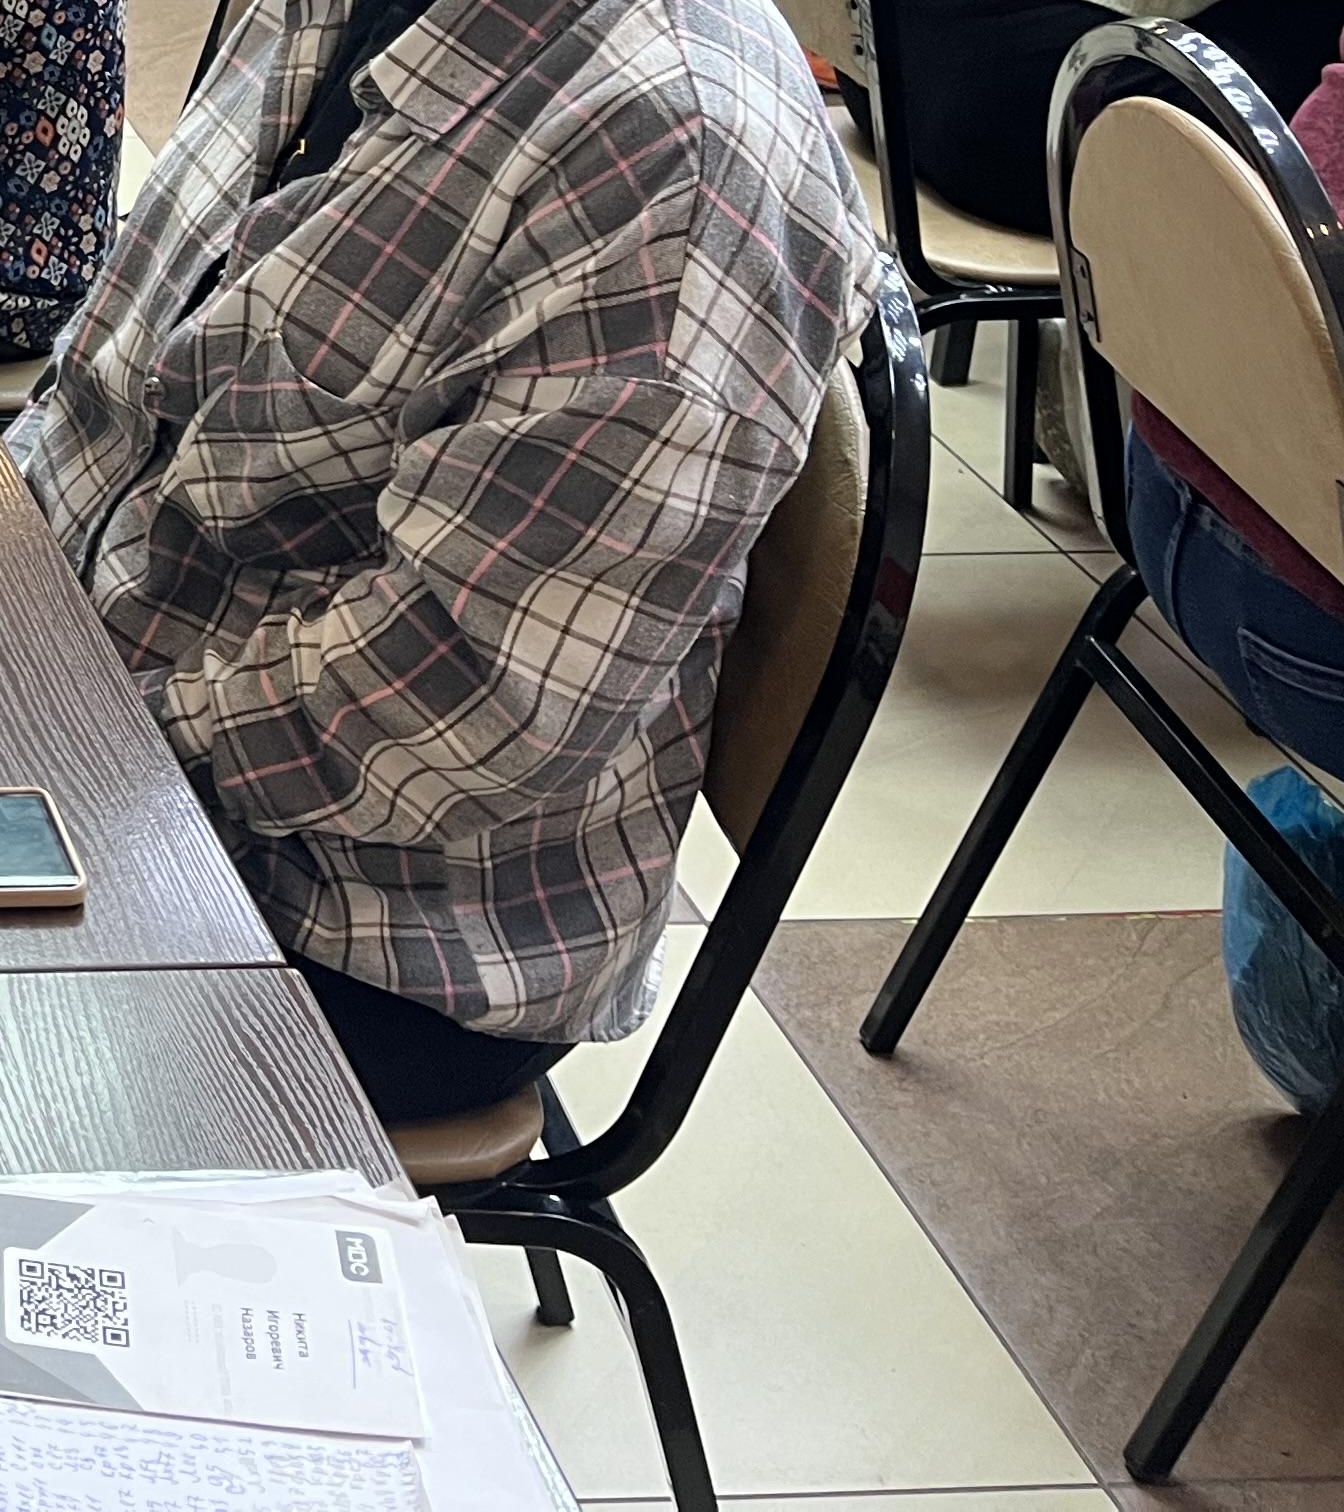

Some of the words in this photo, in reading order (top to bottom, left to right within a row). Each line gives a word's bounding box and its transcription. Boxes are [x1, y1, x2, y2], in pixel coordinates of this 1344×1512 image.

[240, 1307, 257, 1360] Назаров
[266, 1310, 285, 1370] Игоревич
[292, 1313, 310, 1358] Никита
